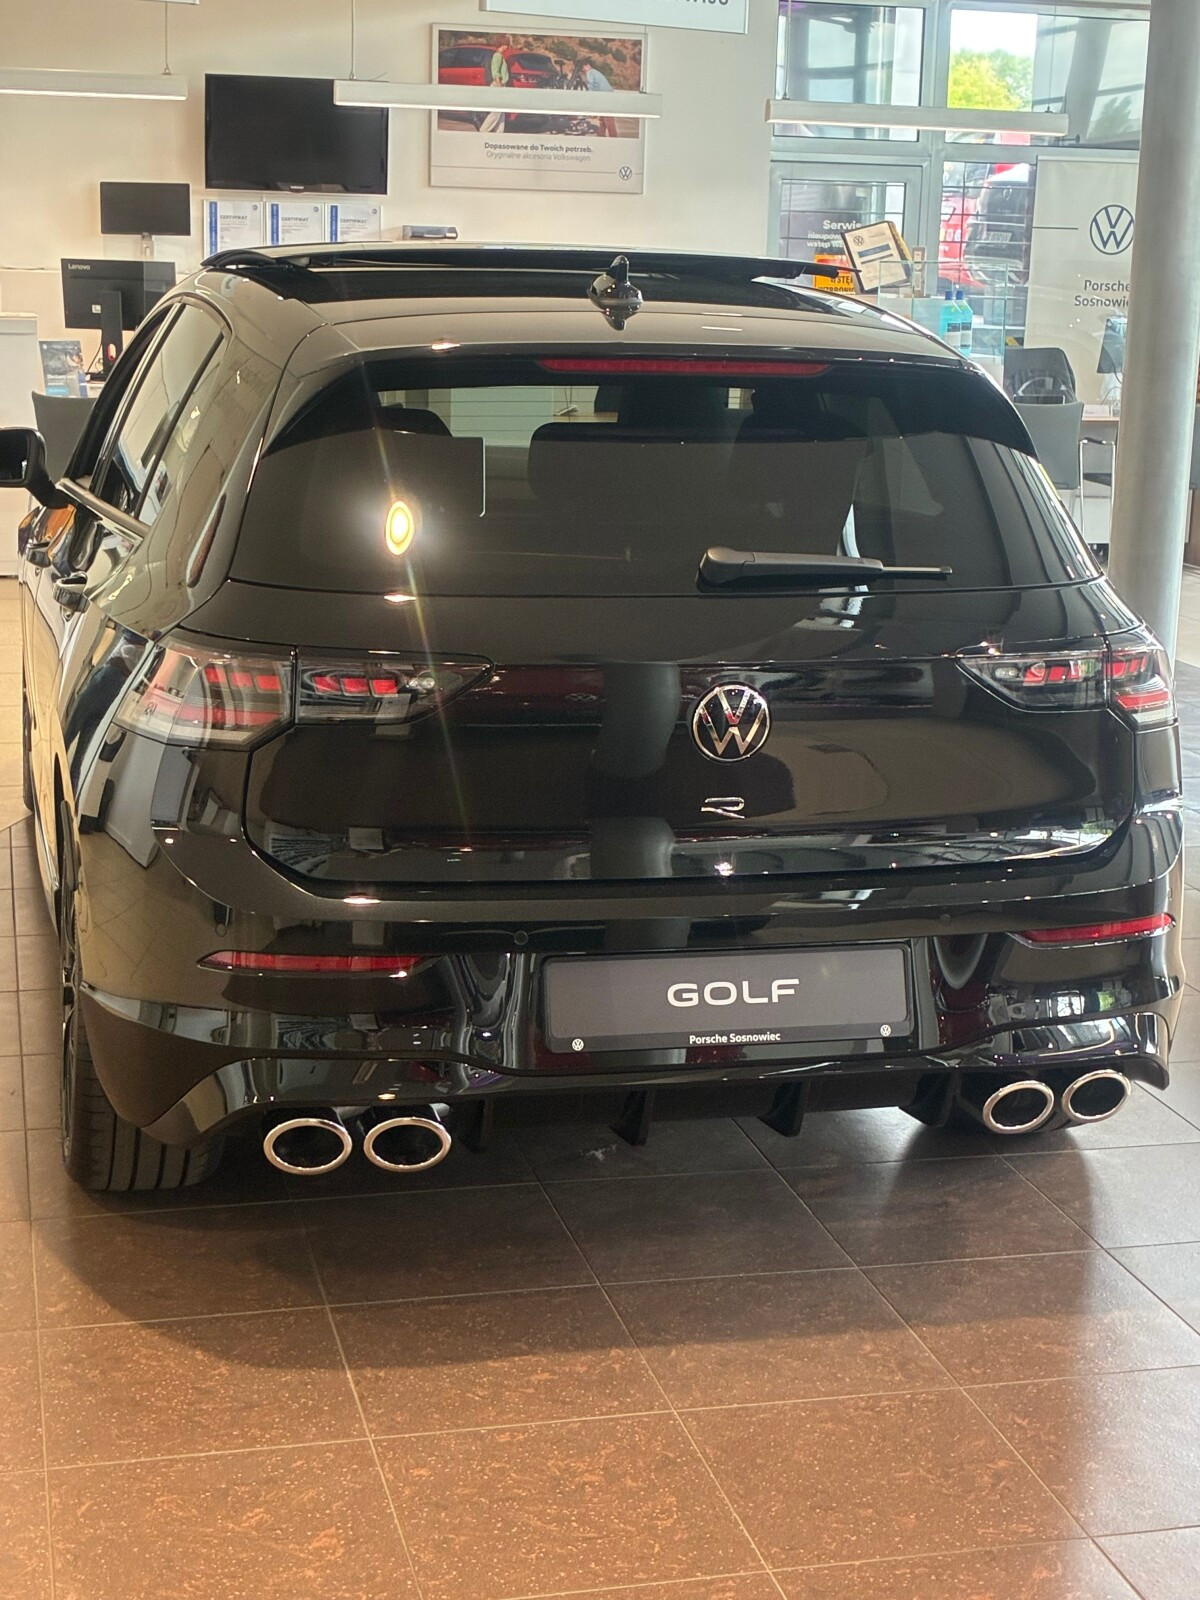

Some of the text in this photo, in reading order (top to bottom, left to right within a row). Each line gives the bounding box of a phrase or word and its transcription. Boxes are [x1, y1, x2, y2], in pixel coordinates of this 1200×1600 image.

[484, 142, 593, 154] Dopasowane do Twoich potrzeb.
[486, 151, 592, 163] Oryginalne akcesoria Volkswagen
[1084, 279, 1130, 292] Porsche
[666, 978, 800, 1008] GOLF
[689, 1031, 781, 1045] Porsche Sosnowiec
